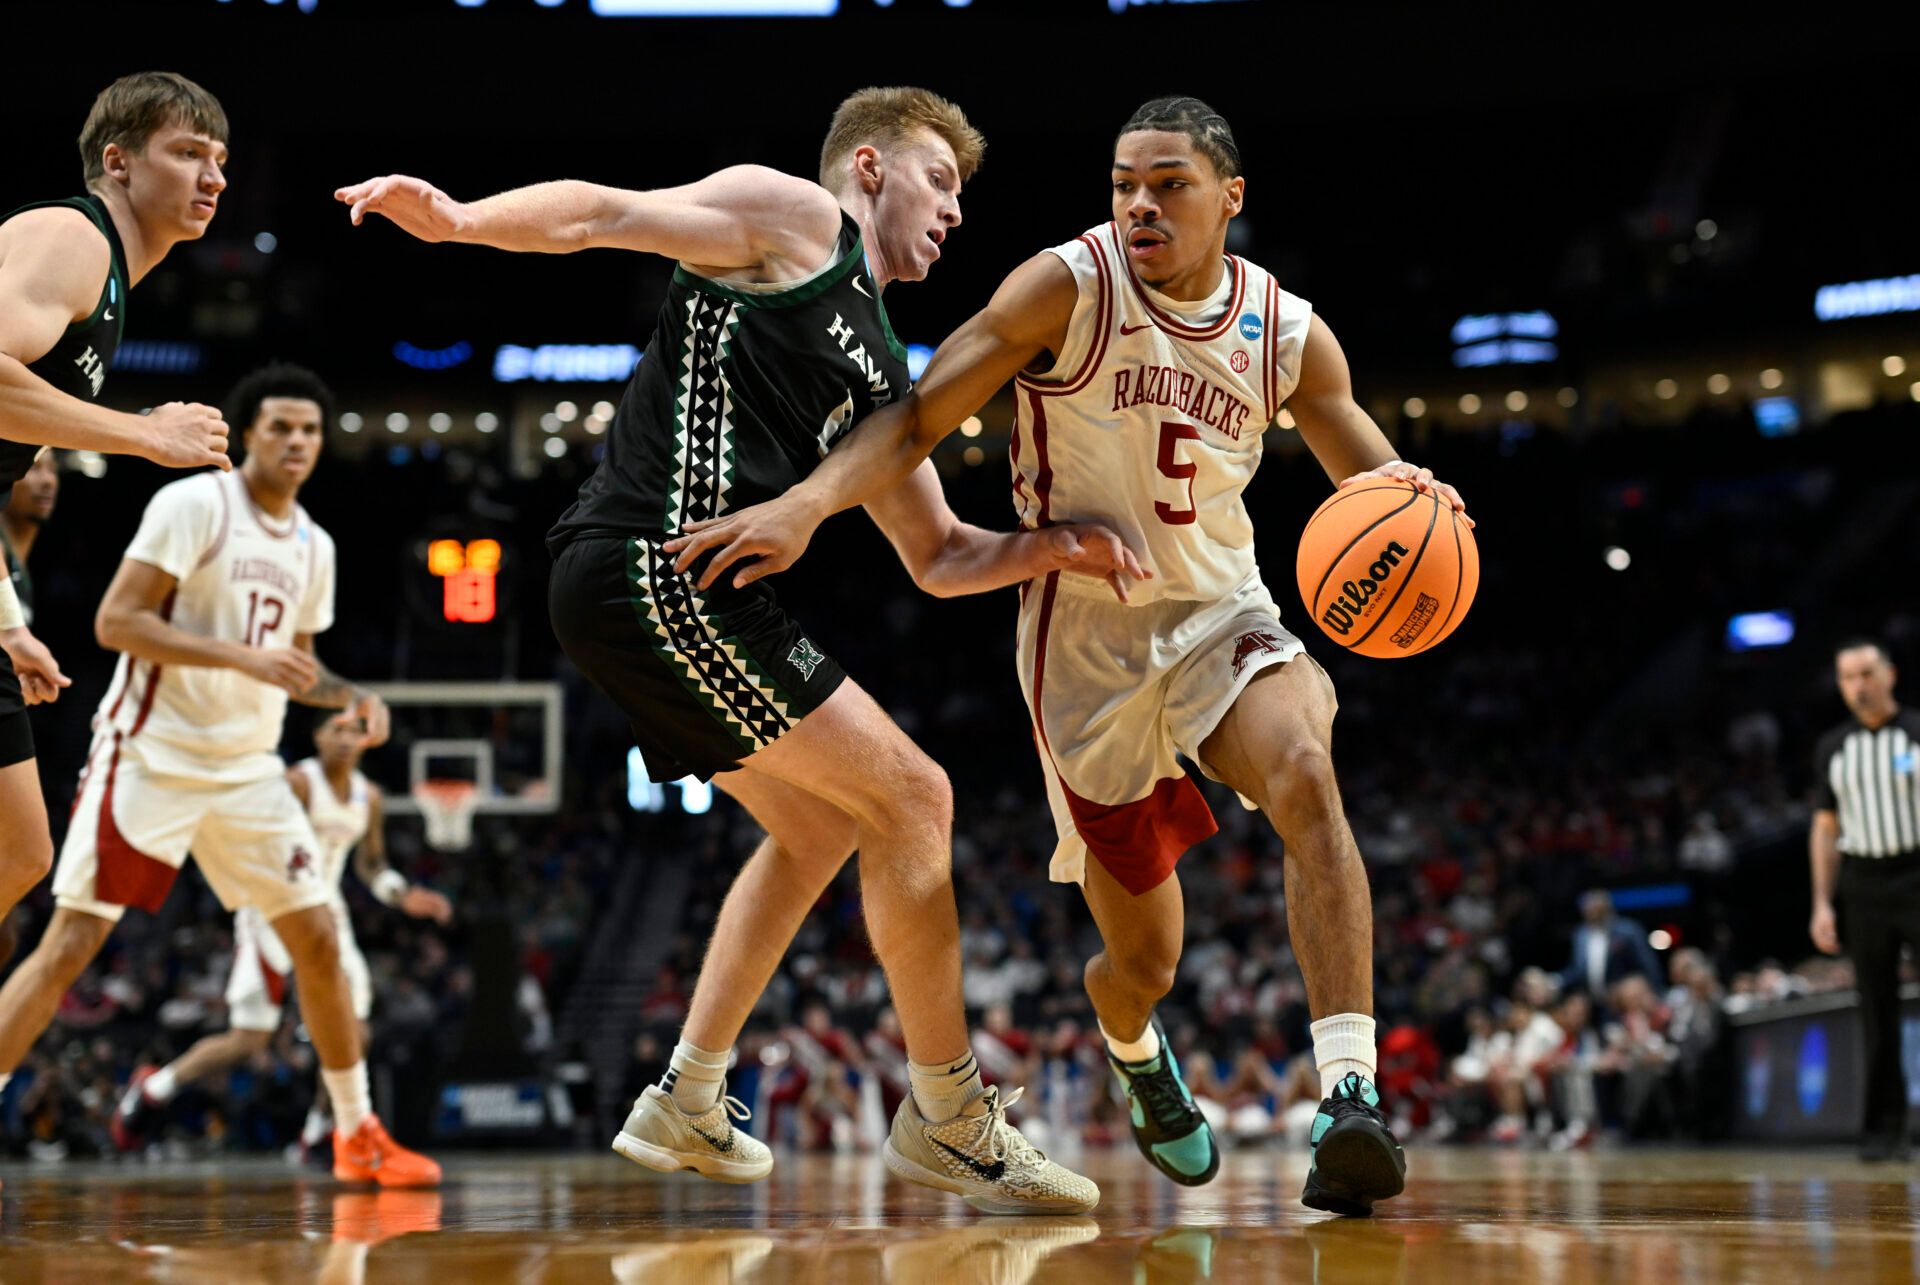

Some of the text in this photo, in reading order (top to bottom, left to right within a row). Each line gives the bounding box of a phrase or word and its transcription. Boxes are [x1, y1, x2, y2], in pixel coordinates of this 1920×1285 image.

[1231, 352, 1248, 371] SEC
[1112, 364, 1250, 441] RAZORBACKS
[1154, 421, 1201, 525] 5
[1321, 541, 1409, 636] Wilson
[1364, 603, 1376, 617] EVO
[245, 591, 284, 648] 12
[1397, 608, 1422, 638] MARCH
[1408, 598, 1438, 640] MADNESS
